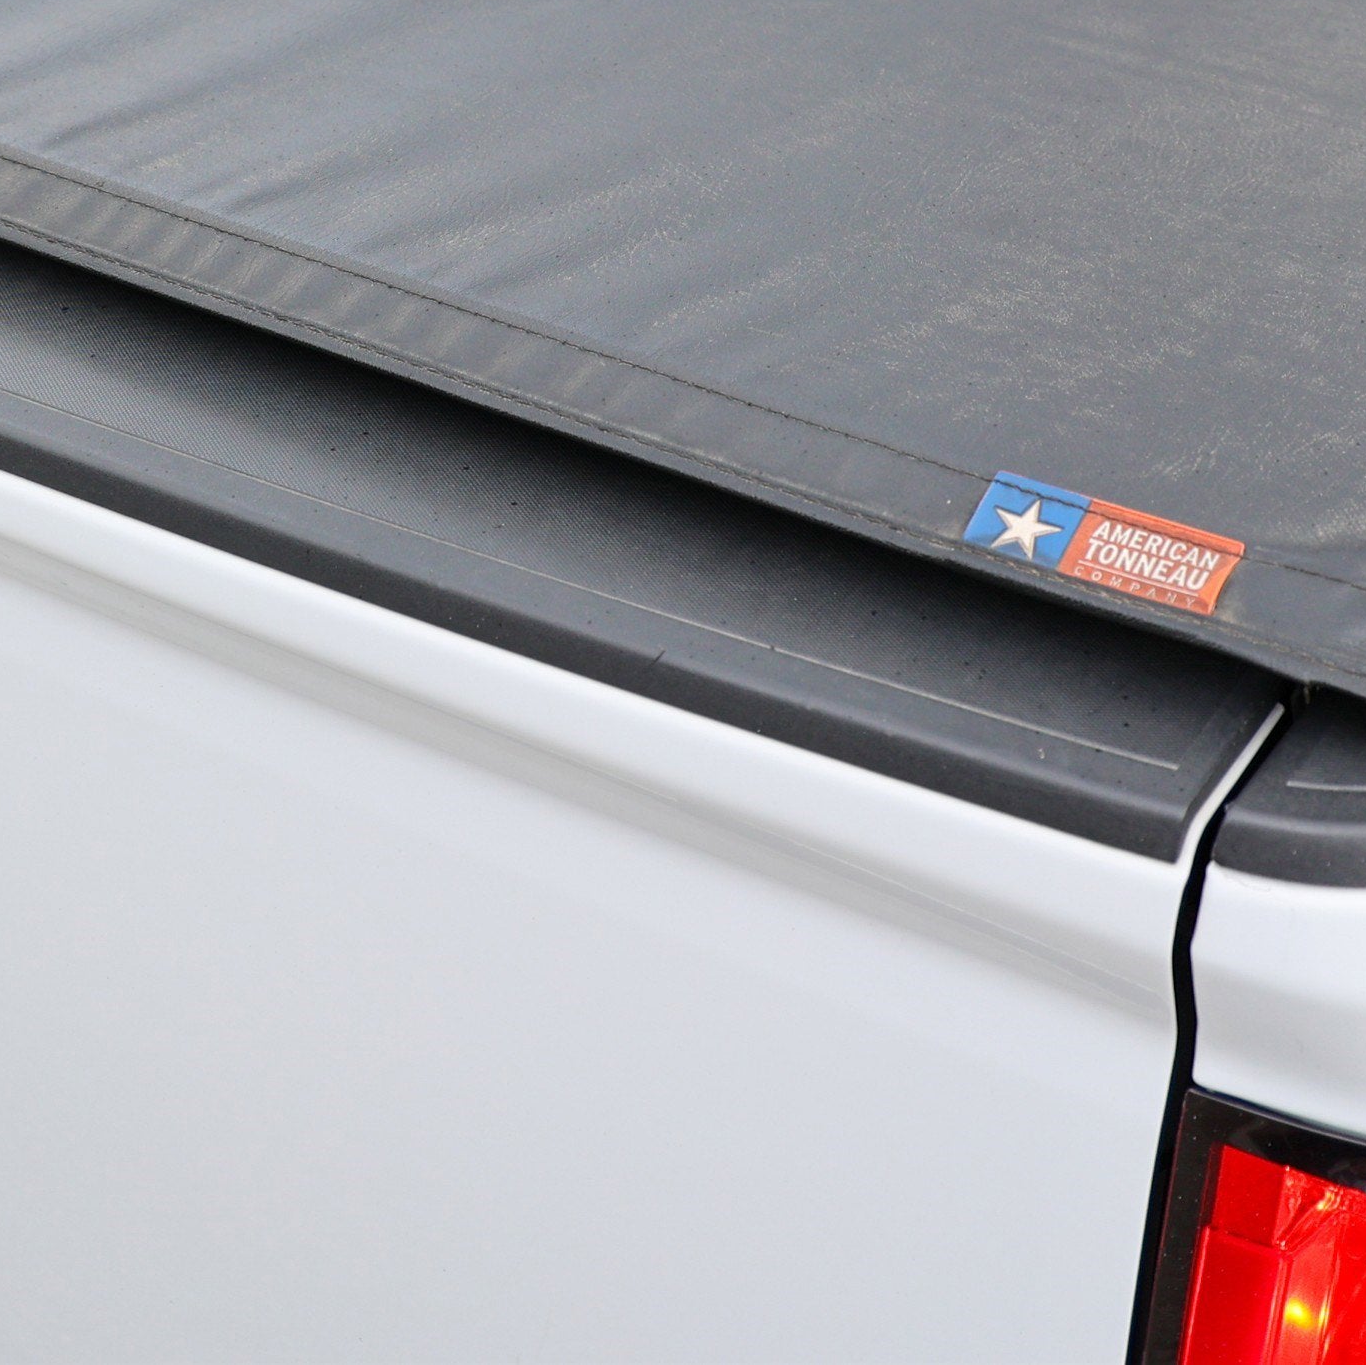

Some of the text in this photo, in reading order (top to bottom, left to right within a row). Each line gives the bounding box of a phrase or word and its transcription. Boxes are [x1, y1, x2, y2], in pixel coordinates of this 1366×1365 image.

[1085, 538, 1210, 590] TONNEAU
[1092, 520, 1220, 571] AMERICAN
[1073, 565, 1197, 608] COMPANY
